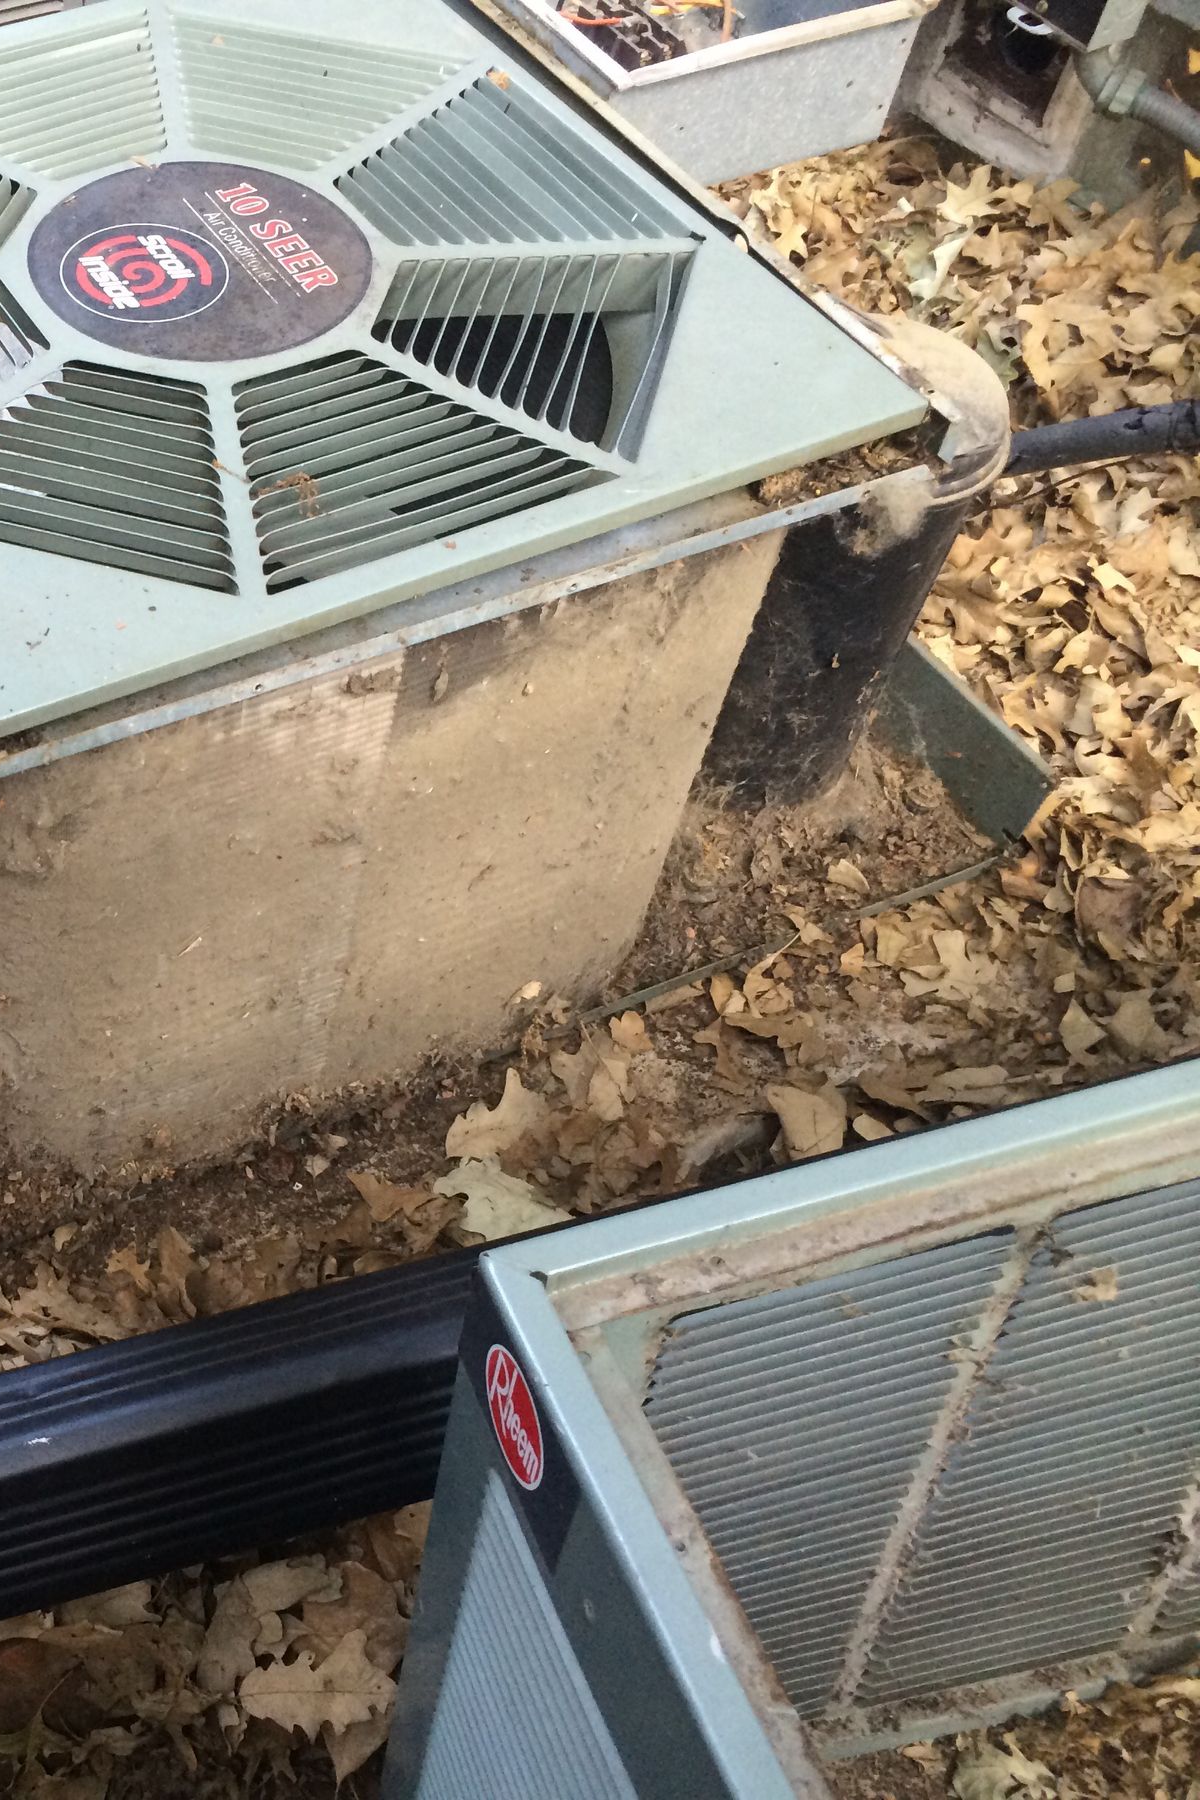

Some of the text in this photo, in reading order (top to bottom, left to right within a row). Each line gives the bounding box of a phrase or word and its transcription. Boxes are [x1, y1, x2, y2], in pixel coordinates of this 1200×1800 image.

[136, 234, 195, 279] Scroll
[203, 212, 276, 282] Air Conditioner
[215, 182, 338, 293] 10 SEER
[78, 255, 141, 310] Inside
[488, 1349, 538, 1484] Rheem
